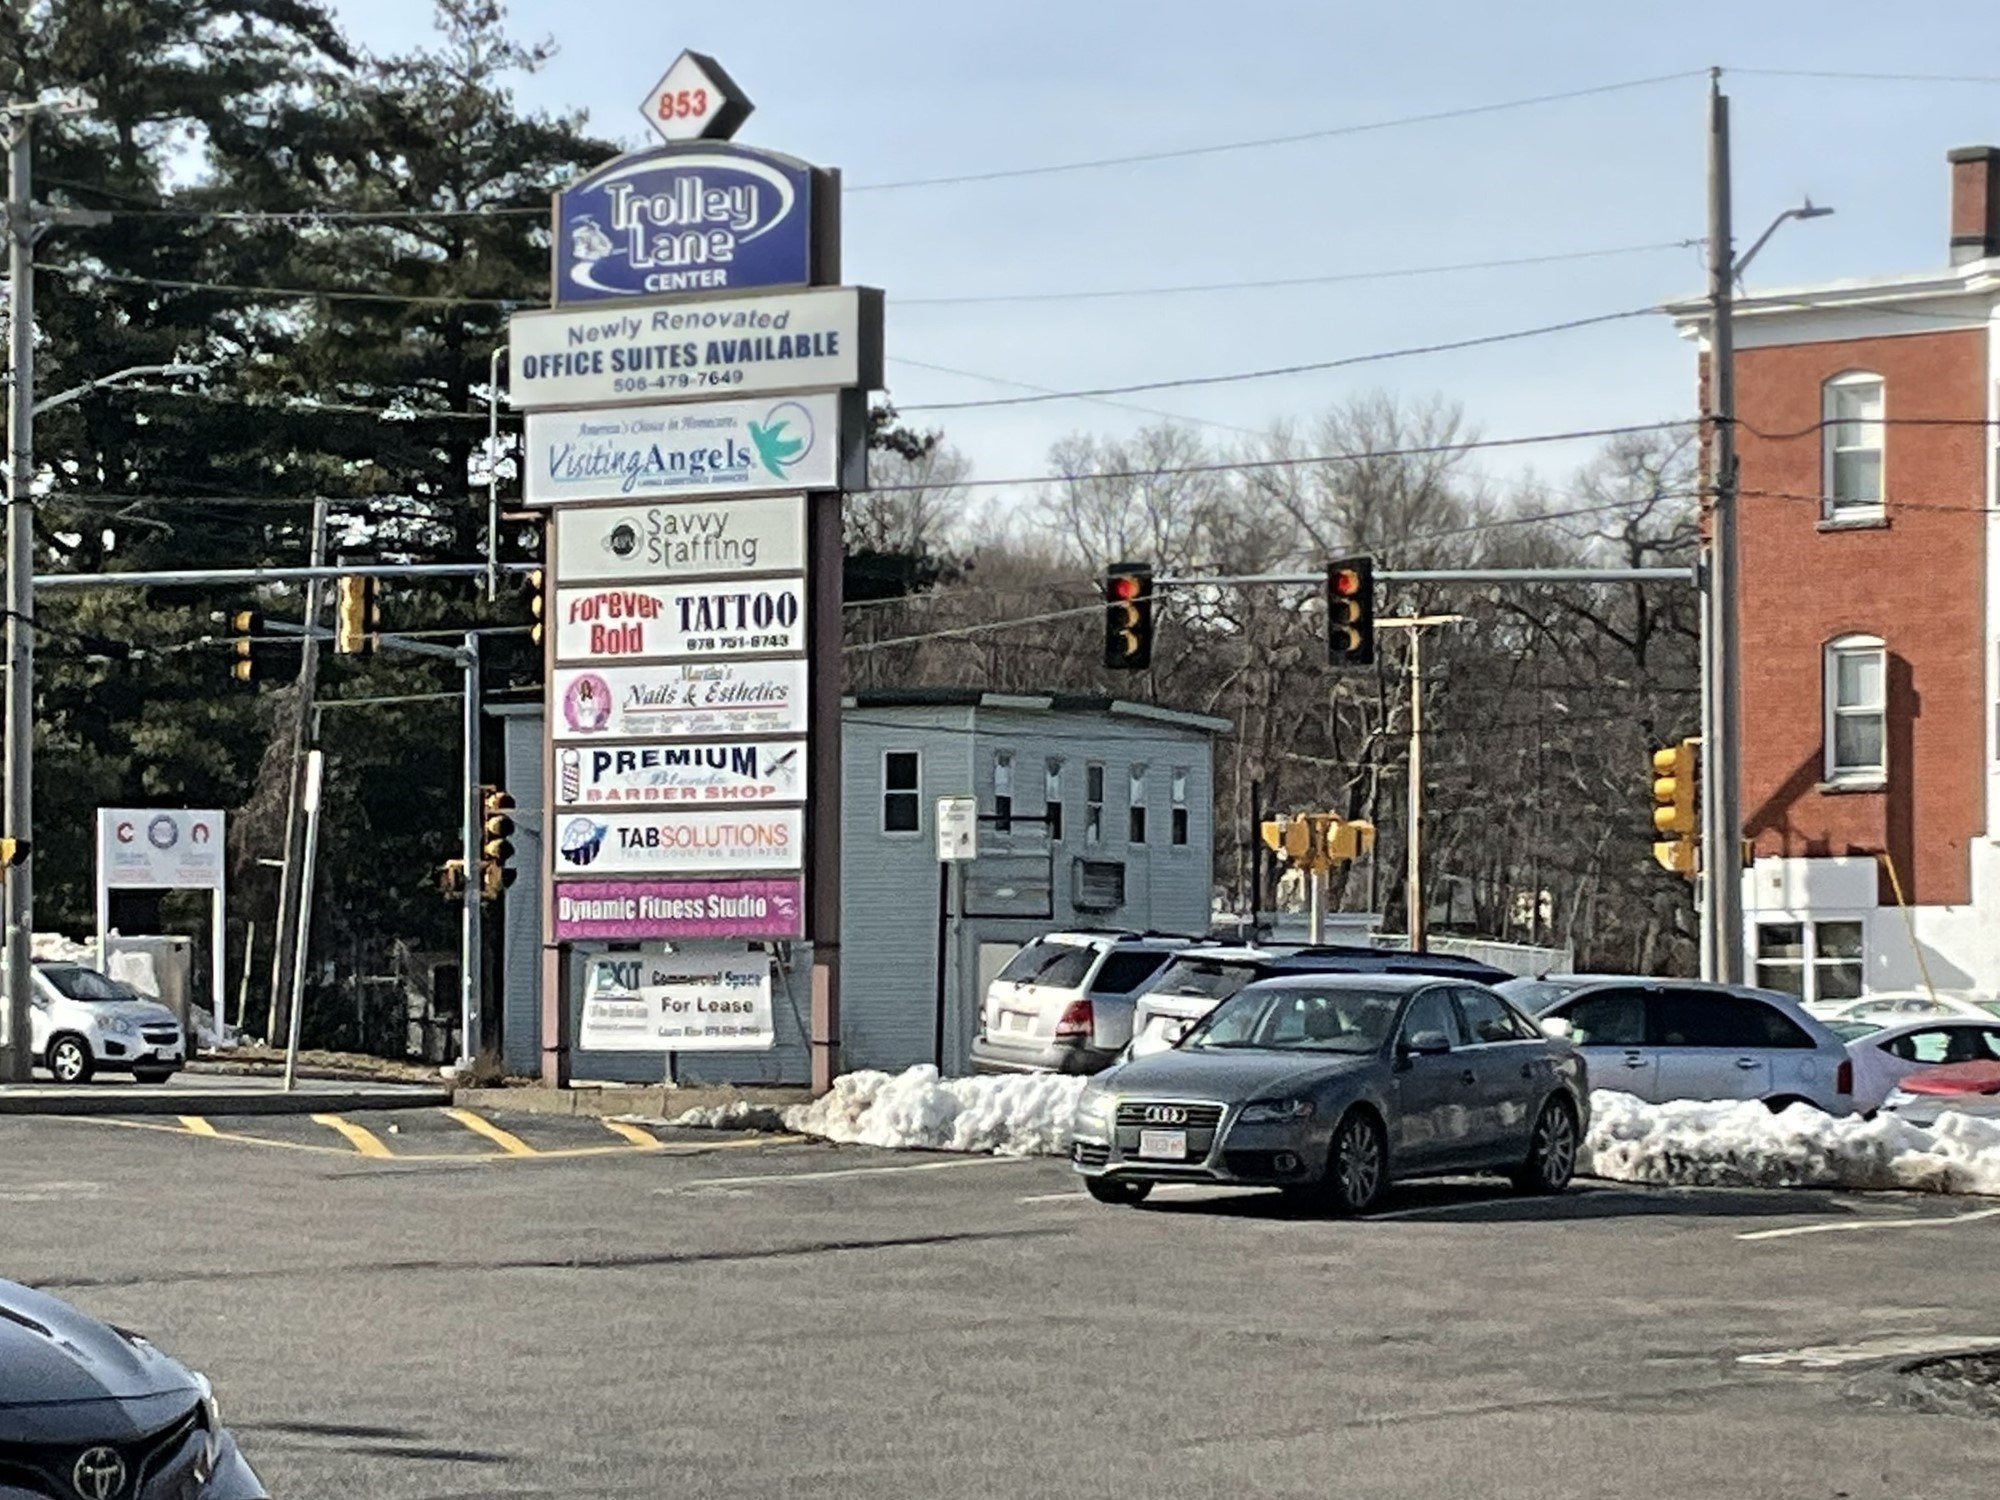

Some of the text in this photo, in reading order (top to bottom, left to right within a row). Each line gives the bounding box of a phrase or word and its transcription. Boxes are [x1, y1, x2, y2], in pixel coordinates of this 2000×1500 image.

[658, 88, 707, 121] 853
[604, 176, 758, 230] Trolley
[629, 224, 735, 269] Lane
[644, 268, 728, 292] CENTER
[568, 309, 790, 346] Newly Renovated
[523, 331, 839, 379] OFFICE SUITES AVAILABLE
[647, 508, 729, 539] Savvy
[648, 536, 759, 569] Staffing
[569, 590, 664, 625] Forever
[675, 591, 798, 633] TATTOO
[590, 622, 643, 655] Bold
[623, 680, 790, 708] Nails & Esthetics
[593, 746, 757, 783] PREMIUM
[586, 785, 776, 802] BARBER SHOP
[559, 894, 767, 922] Dynamic Fitness Studio
[597, 961, 643, 991] EXIT
[661, 997, 690, 1013] For
[697, 996, 754, 1014] Lease
